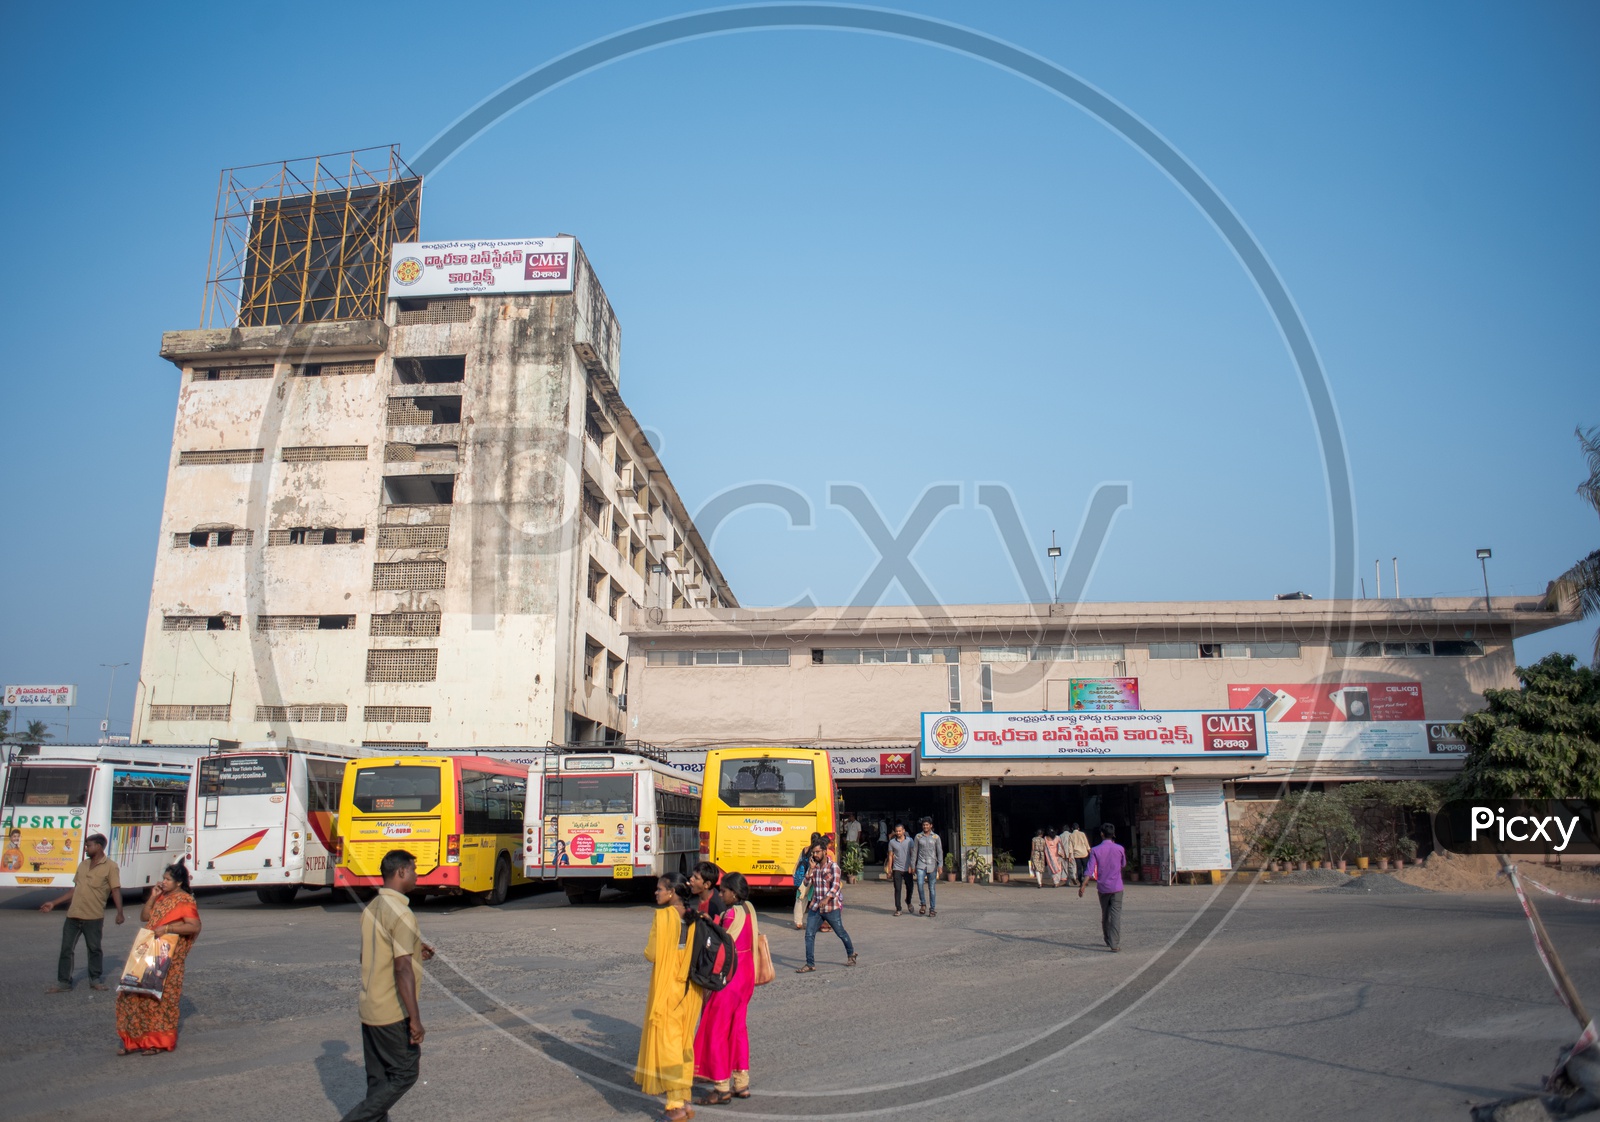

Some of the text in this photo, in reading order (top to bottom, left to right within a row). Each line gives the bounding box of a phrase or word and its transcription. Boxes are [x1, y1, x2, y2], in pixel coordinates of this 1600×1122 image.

[424, 253, 468, 269] ద్వారకా
[529, 254, 565, 266] CMR
[448, 269, 495, 286] కాంప్లెక్స్
[1206, 716, 1253, 732] CMR
[1430, 725, 1456, 738] CM
[974, 728, 1038, 746] ద్వారకా
[1123, 725, 1193, 744] కాంప్లెక్స్
[1213, 738, 1249, 749] విశాఖ
[2, 815, 82, 828] APSRTC
[305, 856, 326, 871] SUPER
